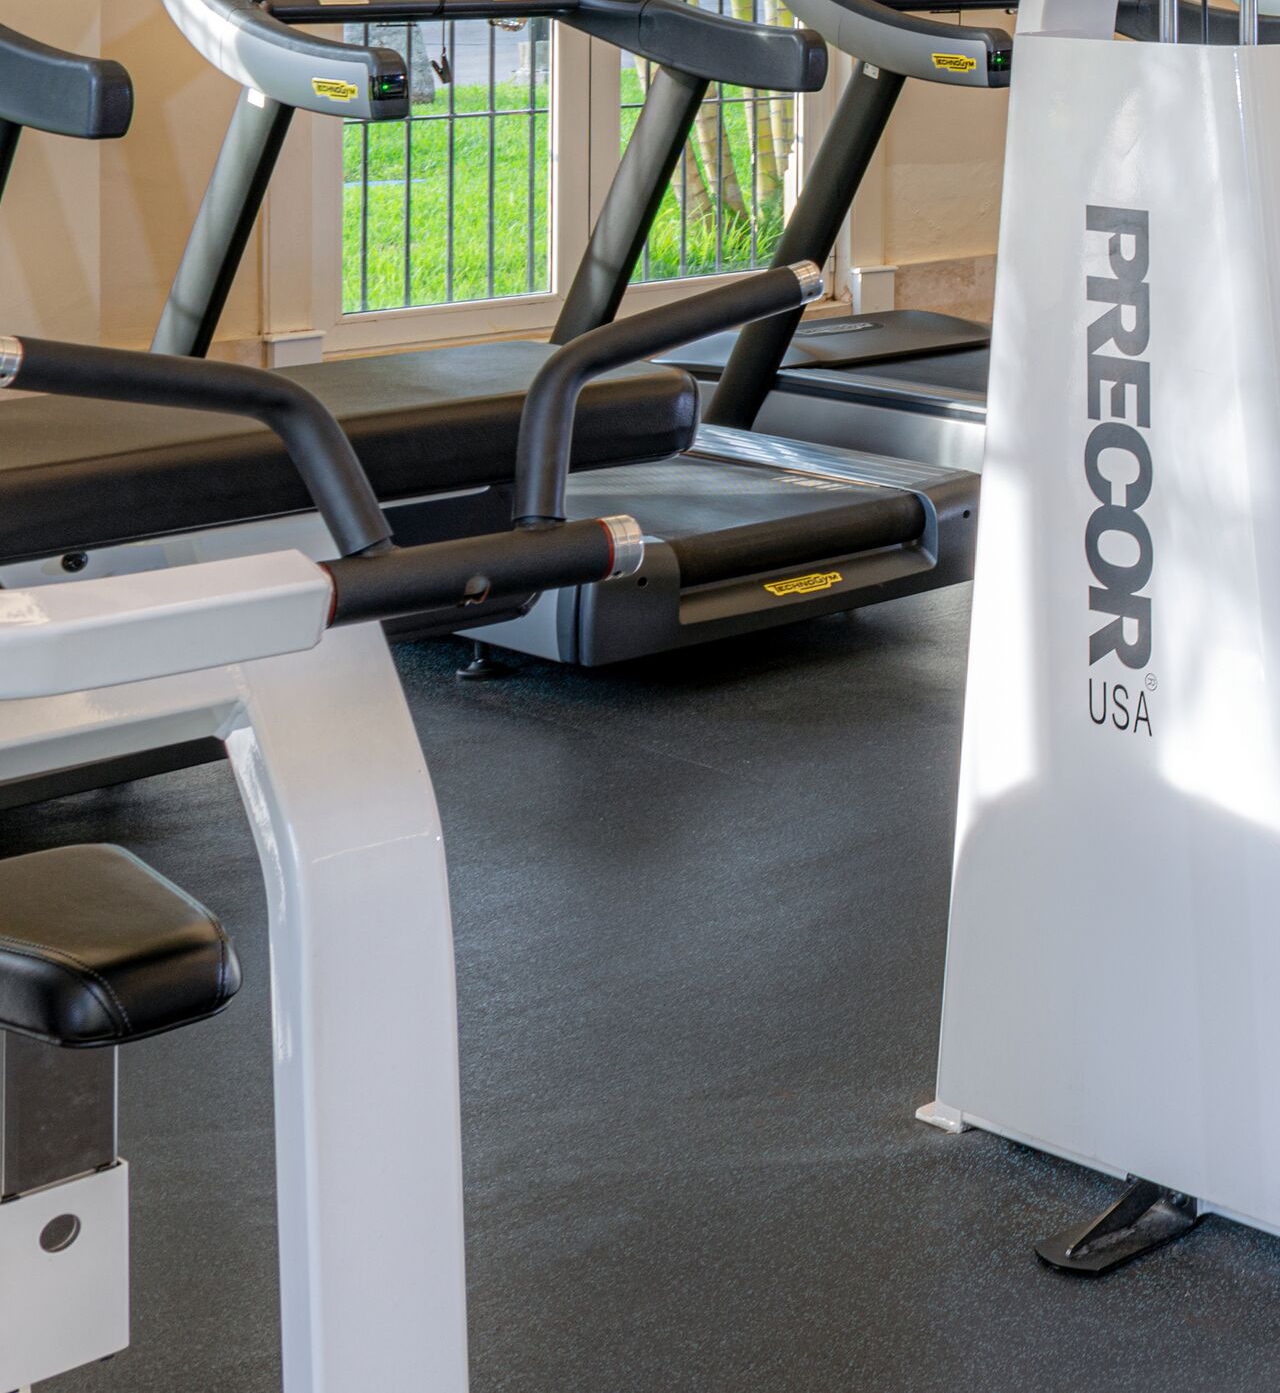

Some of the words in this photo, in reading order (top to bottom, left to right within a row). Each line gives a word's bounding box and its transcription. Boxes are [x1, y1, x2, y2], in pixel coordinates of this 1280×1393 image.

[933, 54, 975, 70] TECHNOGYM
[1084, 204, 1153, 671] PRECOR
[767, 574, 841, 593] TECHNOGYM
[1088, 678, 1153, 737] USA
